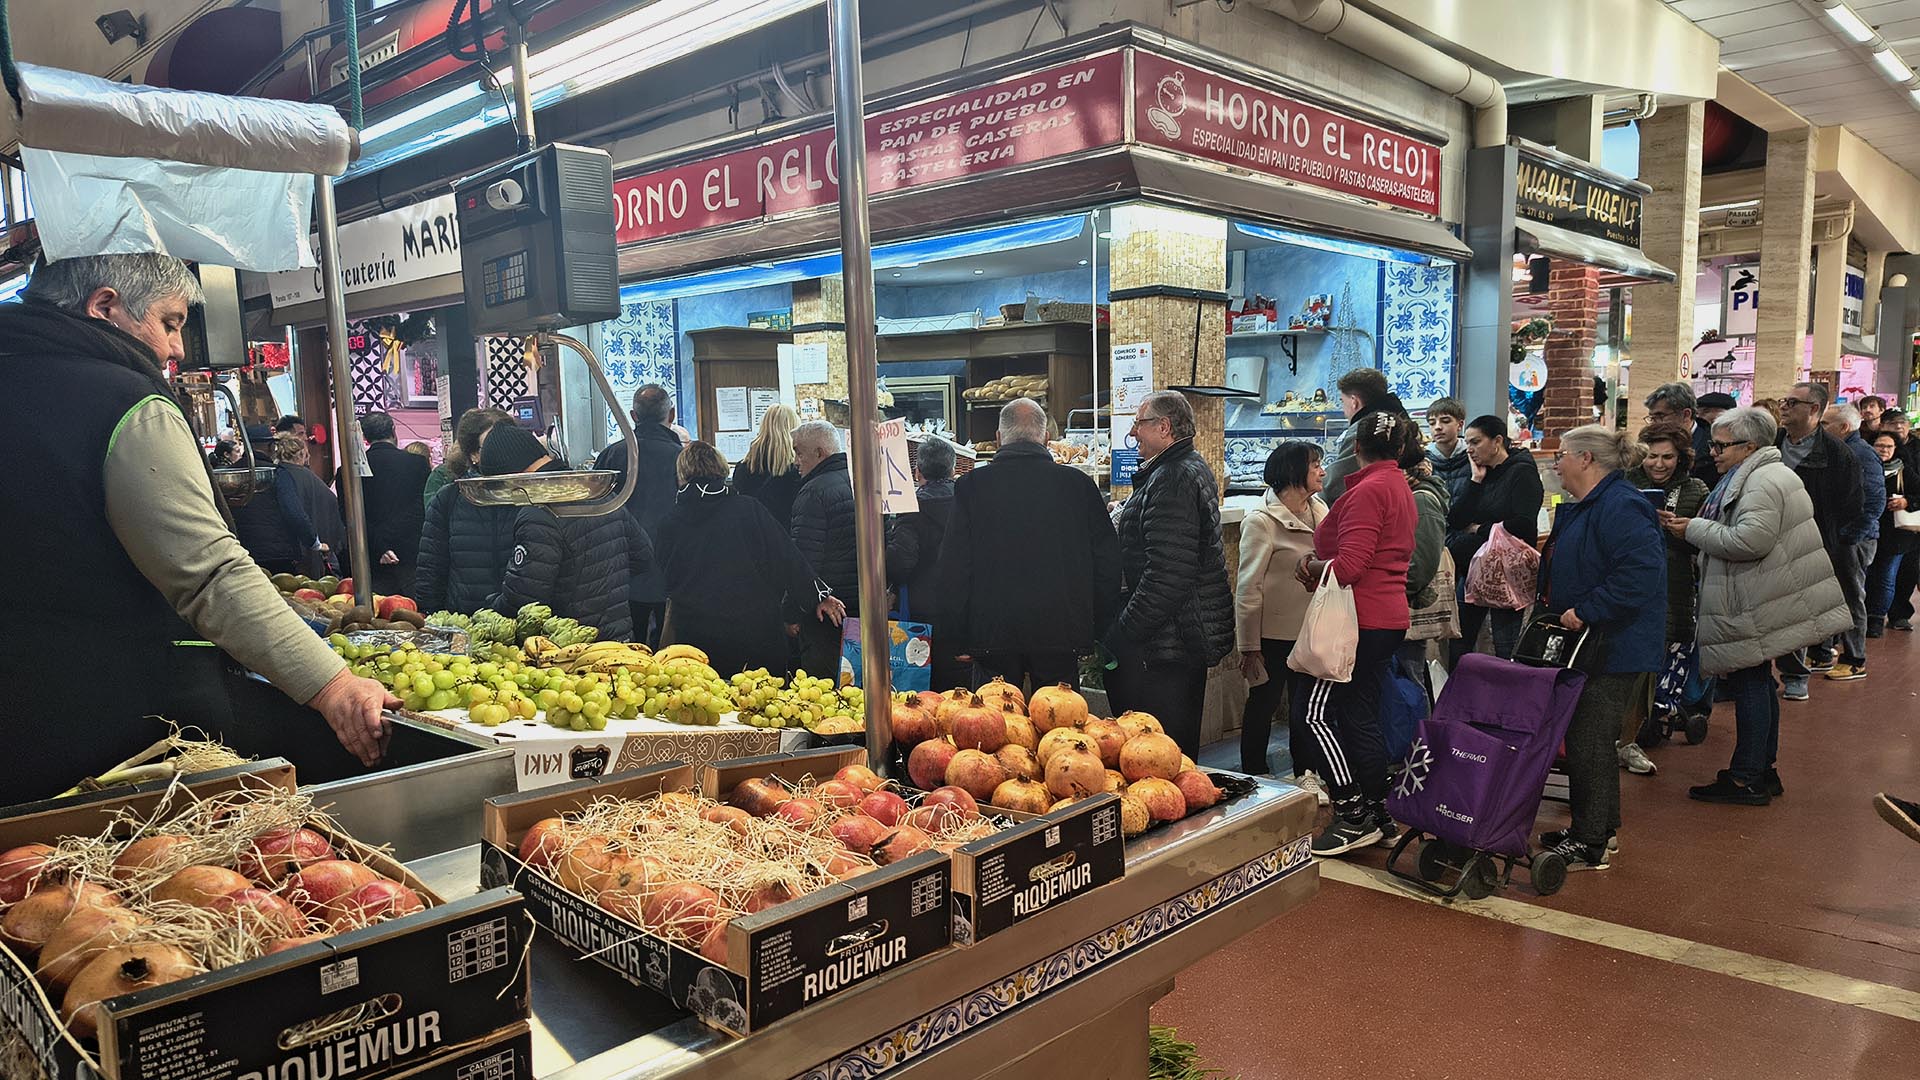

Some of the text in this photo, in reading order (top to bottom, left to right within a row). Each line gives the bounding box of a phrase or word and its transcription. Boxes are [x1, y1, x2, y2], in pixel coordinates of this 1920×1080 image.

[880, 68, 1095, 134] ESPECIALIDAD EN
[880, 95, 1067, 151] PAN DE PUEBLO
[880, 111, 1076, 168] PASTAS CASERAS
[1206, 83, 1427, 186] HORNO EL RELOJ
[880, 144, 1016, 183] PASTELERIA
[1192, 128, 1256, 161] ESPECIALIDAD
[1258, 146, 1270, 165] EN
[1271, 150, 1288, 170] PAN
[1289, 155, 1301, 173] DE
[1301, 158, 1332, 181] PUEBLO
[1333, 166, 1340, 177] Y
[1339, 168, 1366, 189] PASTAS
[613, 138, 839, 231] ORNO EL RELO
[1516, 161, 1639, 231] MIGUEL VICENT
[1728, 210, 1757, 218] PASILLO
[402, 212, 458, 262] MARI
[524, 752, 563, 776] KAKI
[1451, 747, 1487, 763] THERMO
[1440, 808, 1474, 824] ROLSER
[1014, 862, 1091, 916] RIQUEMUR
[460, 923, 495, 938] CALIBRE
[528, 874, 668, 956] GRANADAS DE ALBATERA
[451, 935, 491, 954] 10 15
[451, 947, 491, 967] 12 18
[551, 901, 641, 978] RIQUEMUR
[840, 941, 874, 960] FRUTAS
[452, 960, 492, 980] 13 20
[804, 935, 907, 1001] RIQUEMUR
[155, 1015, 188, 1033] FRUTAS
[488, 1067, 498, 1077] 15
